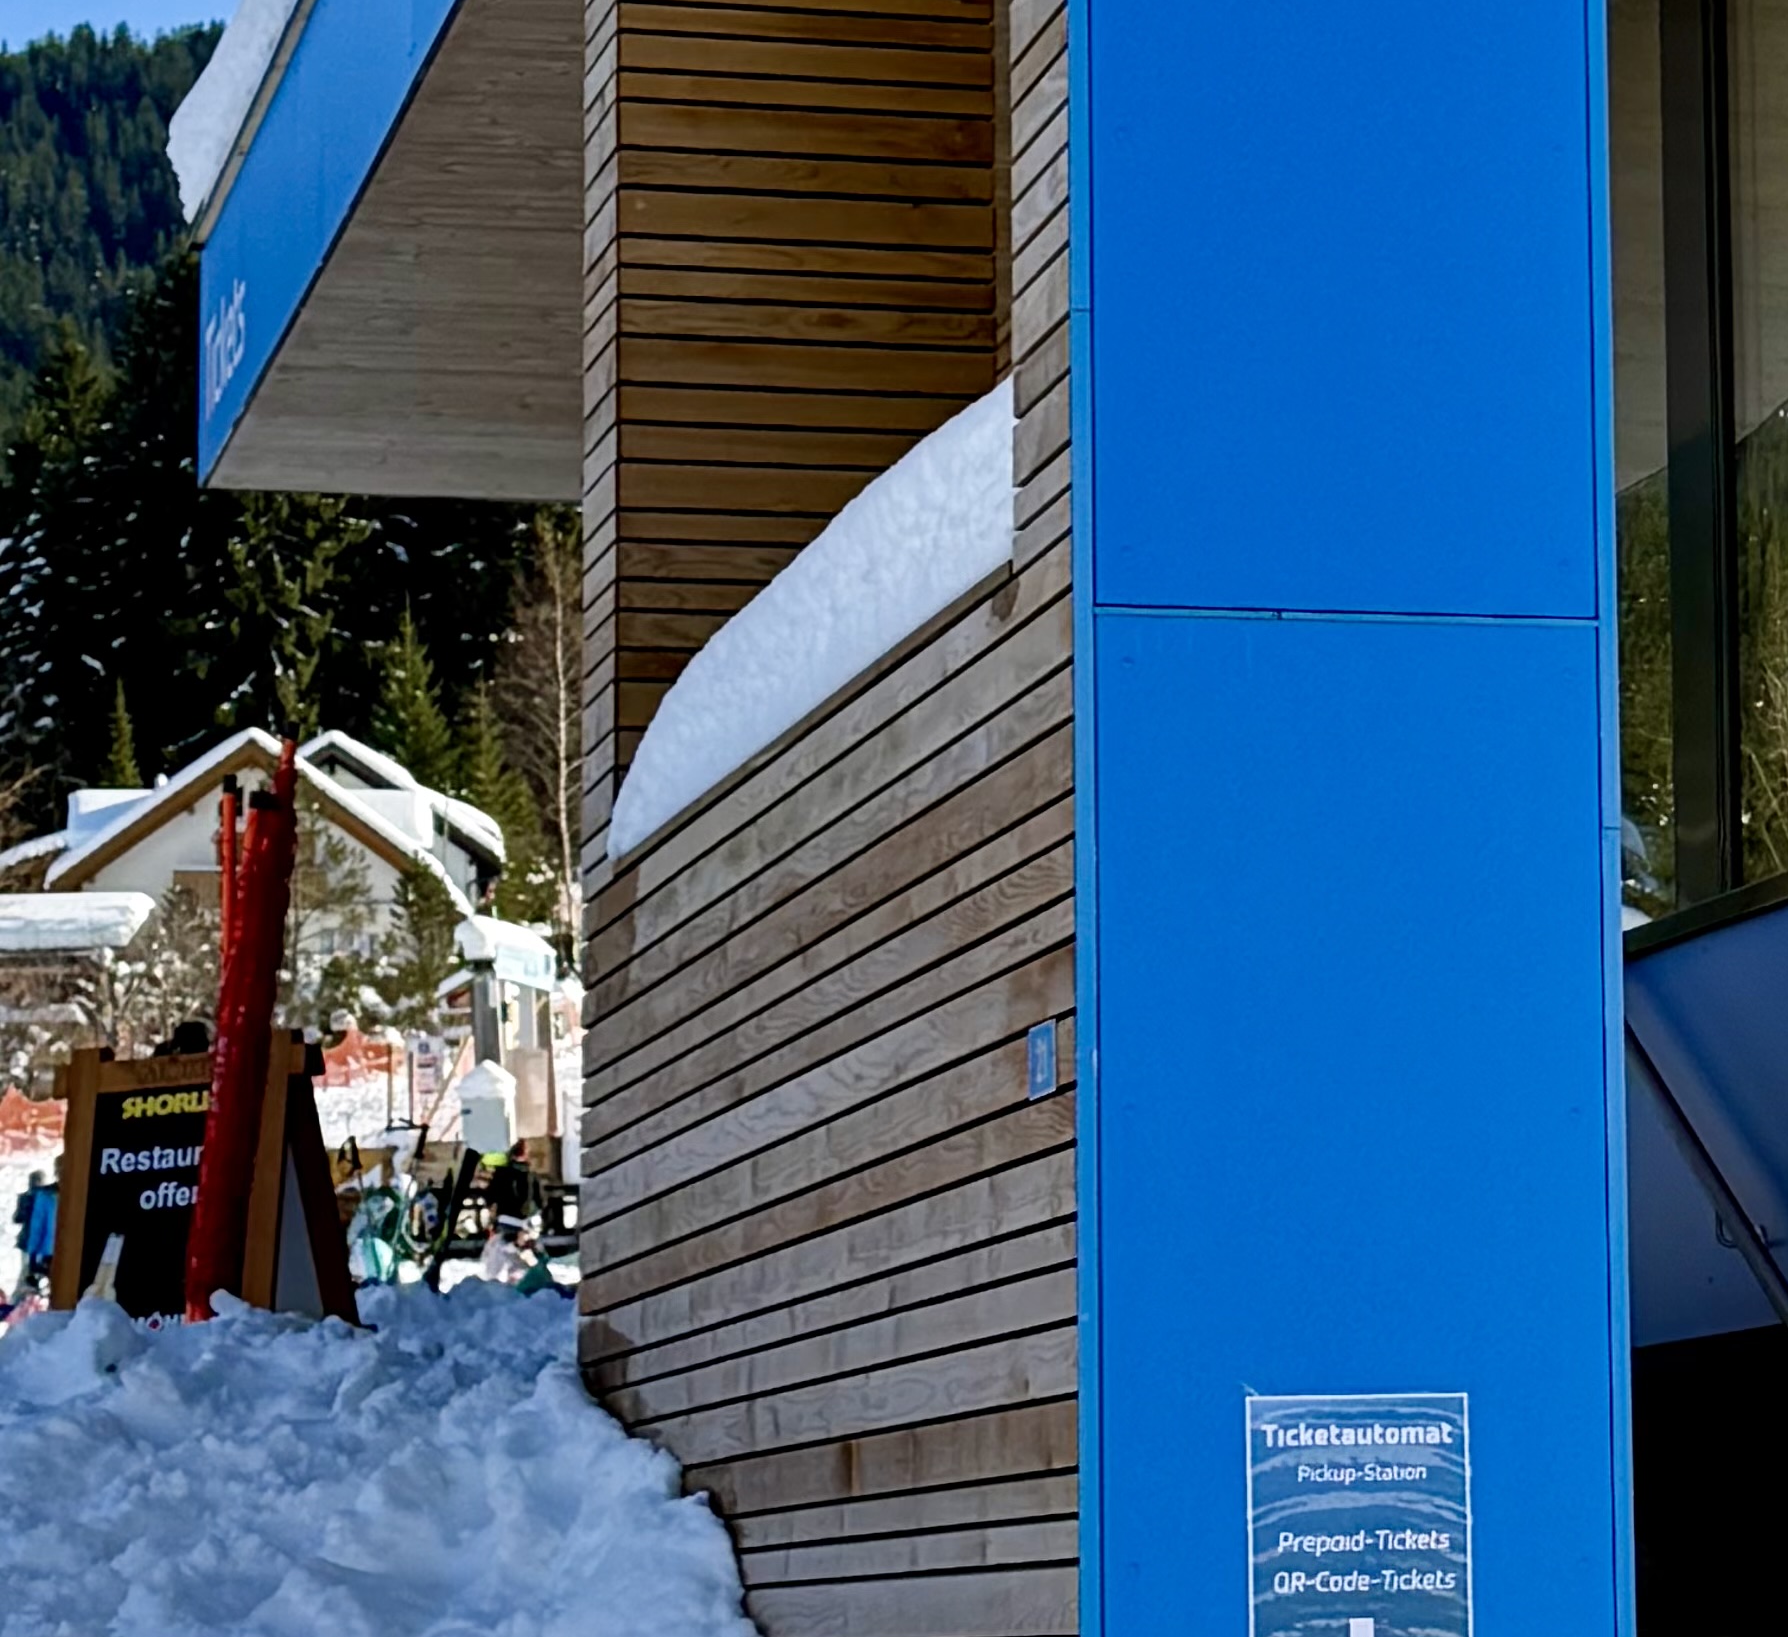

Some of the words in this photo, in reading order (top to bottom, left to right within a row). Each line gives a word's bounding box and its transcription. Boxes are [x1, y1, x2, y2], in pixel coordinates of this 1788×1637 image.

[1261, 1422, 1453, 1448] Ticketautomat
[1298, 1463, 1427, 1485] Pickup-Station
[1277, 1529, 1451, 1556] Prepaid-Tickets
[1273, 1569, 1456, 1594] QR-Code-Tickets
